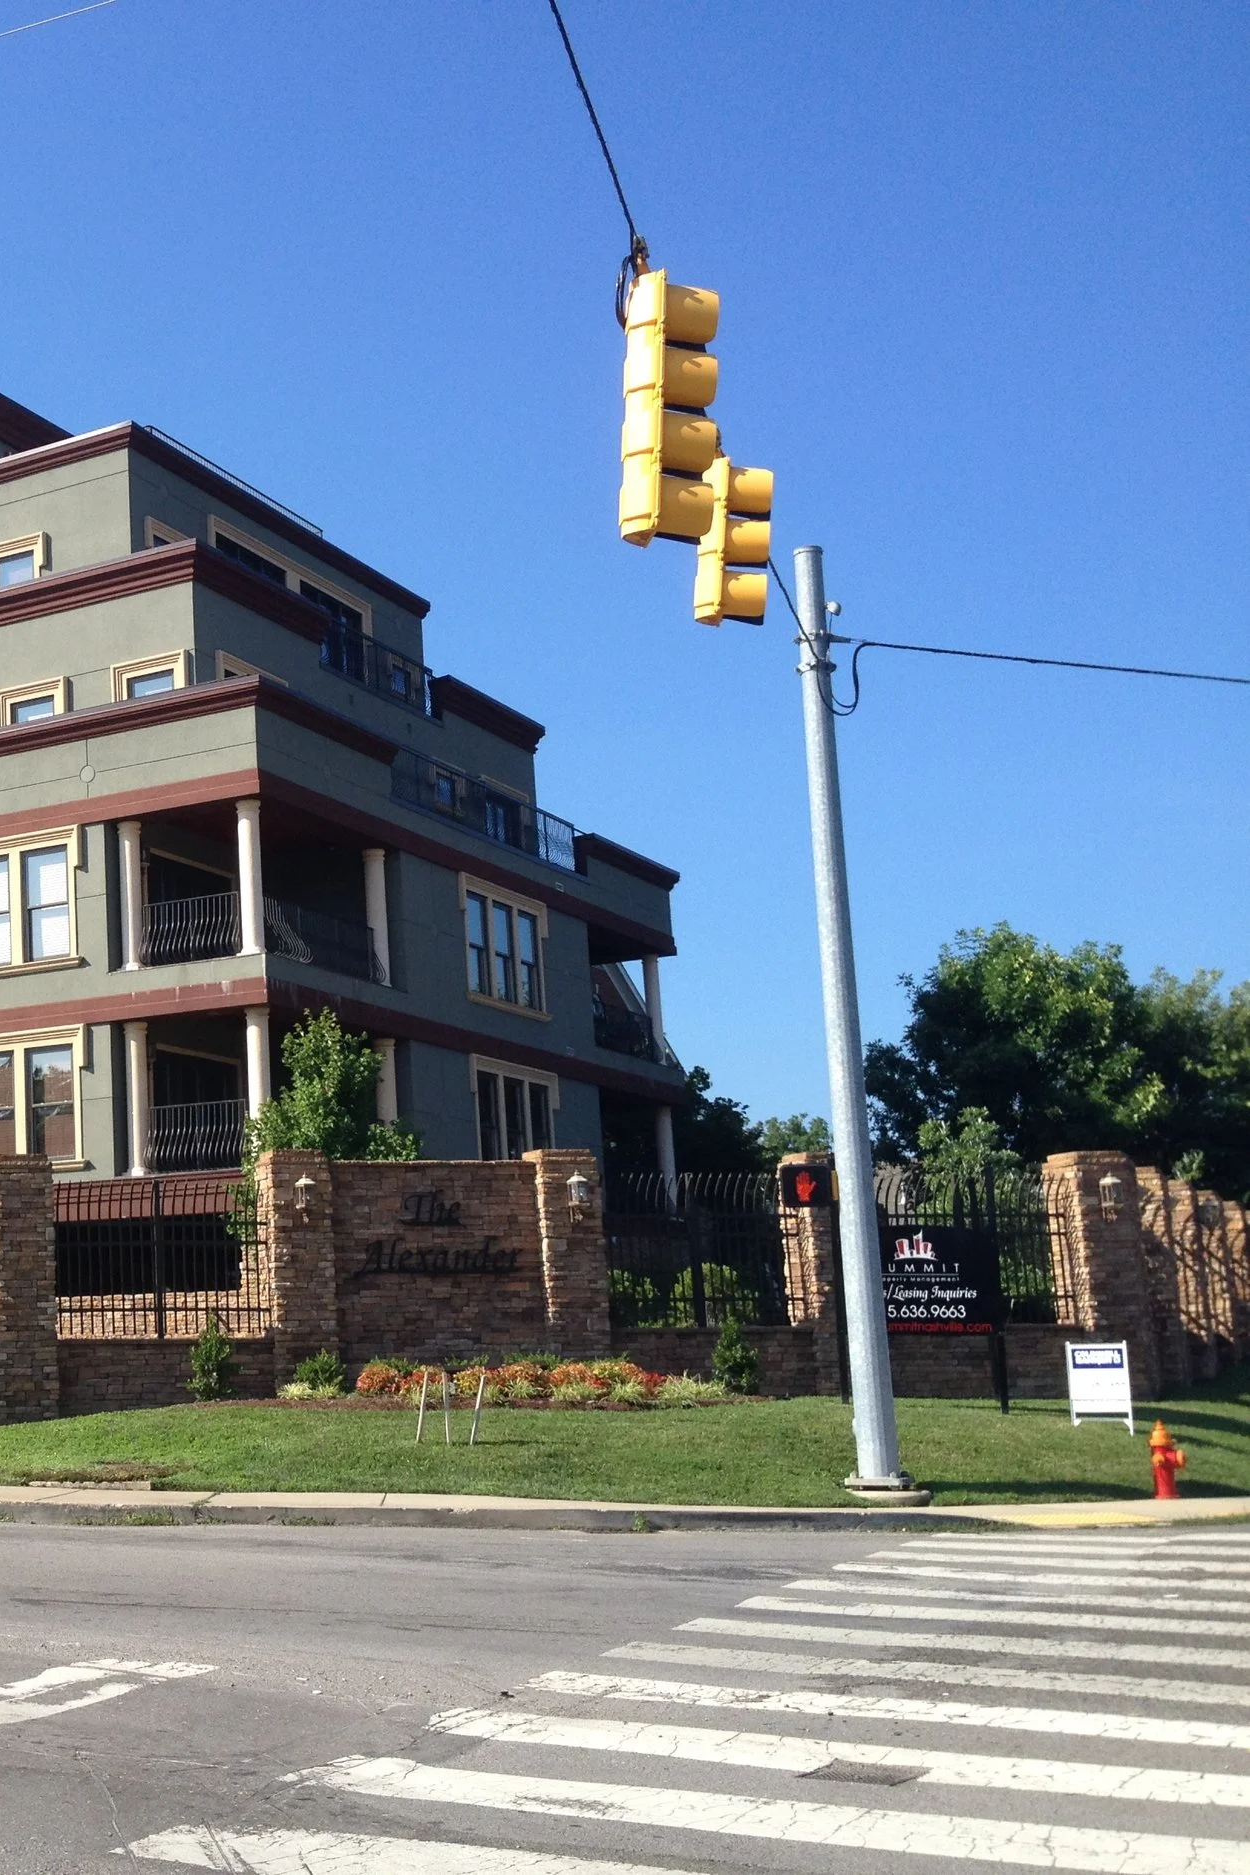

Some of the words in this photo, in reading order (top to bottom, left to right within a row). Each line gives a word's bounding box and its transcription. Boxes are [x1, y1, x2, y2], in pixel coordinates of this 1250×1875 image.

[402, 1189, 463, 1226] The
[352, 1238, 520, 1275] Alexander
[888, 1263, 960, 1273] UMMIT
[882, 1283, 928, 1302] s/Leasing
[930, 1285, 978, 1302] Inquiries
[887, 1304, 967, 1319] 5.636.9663
